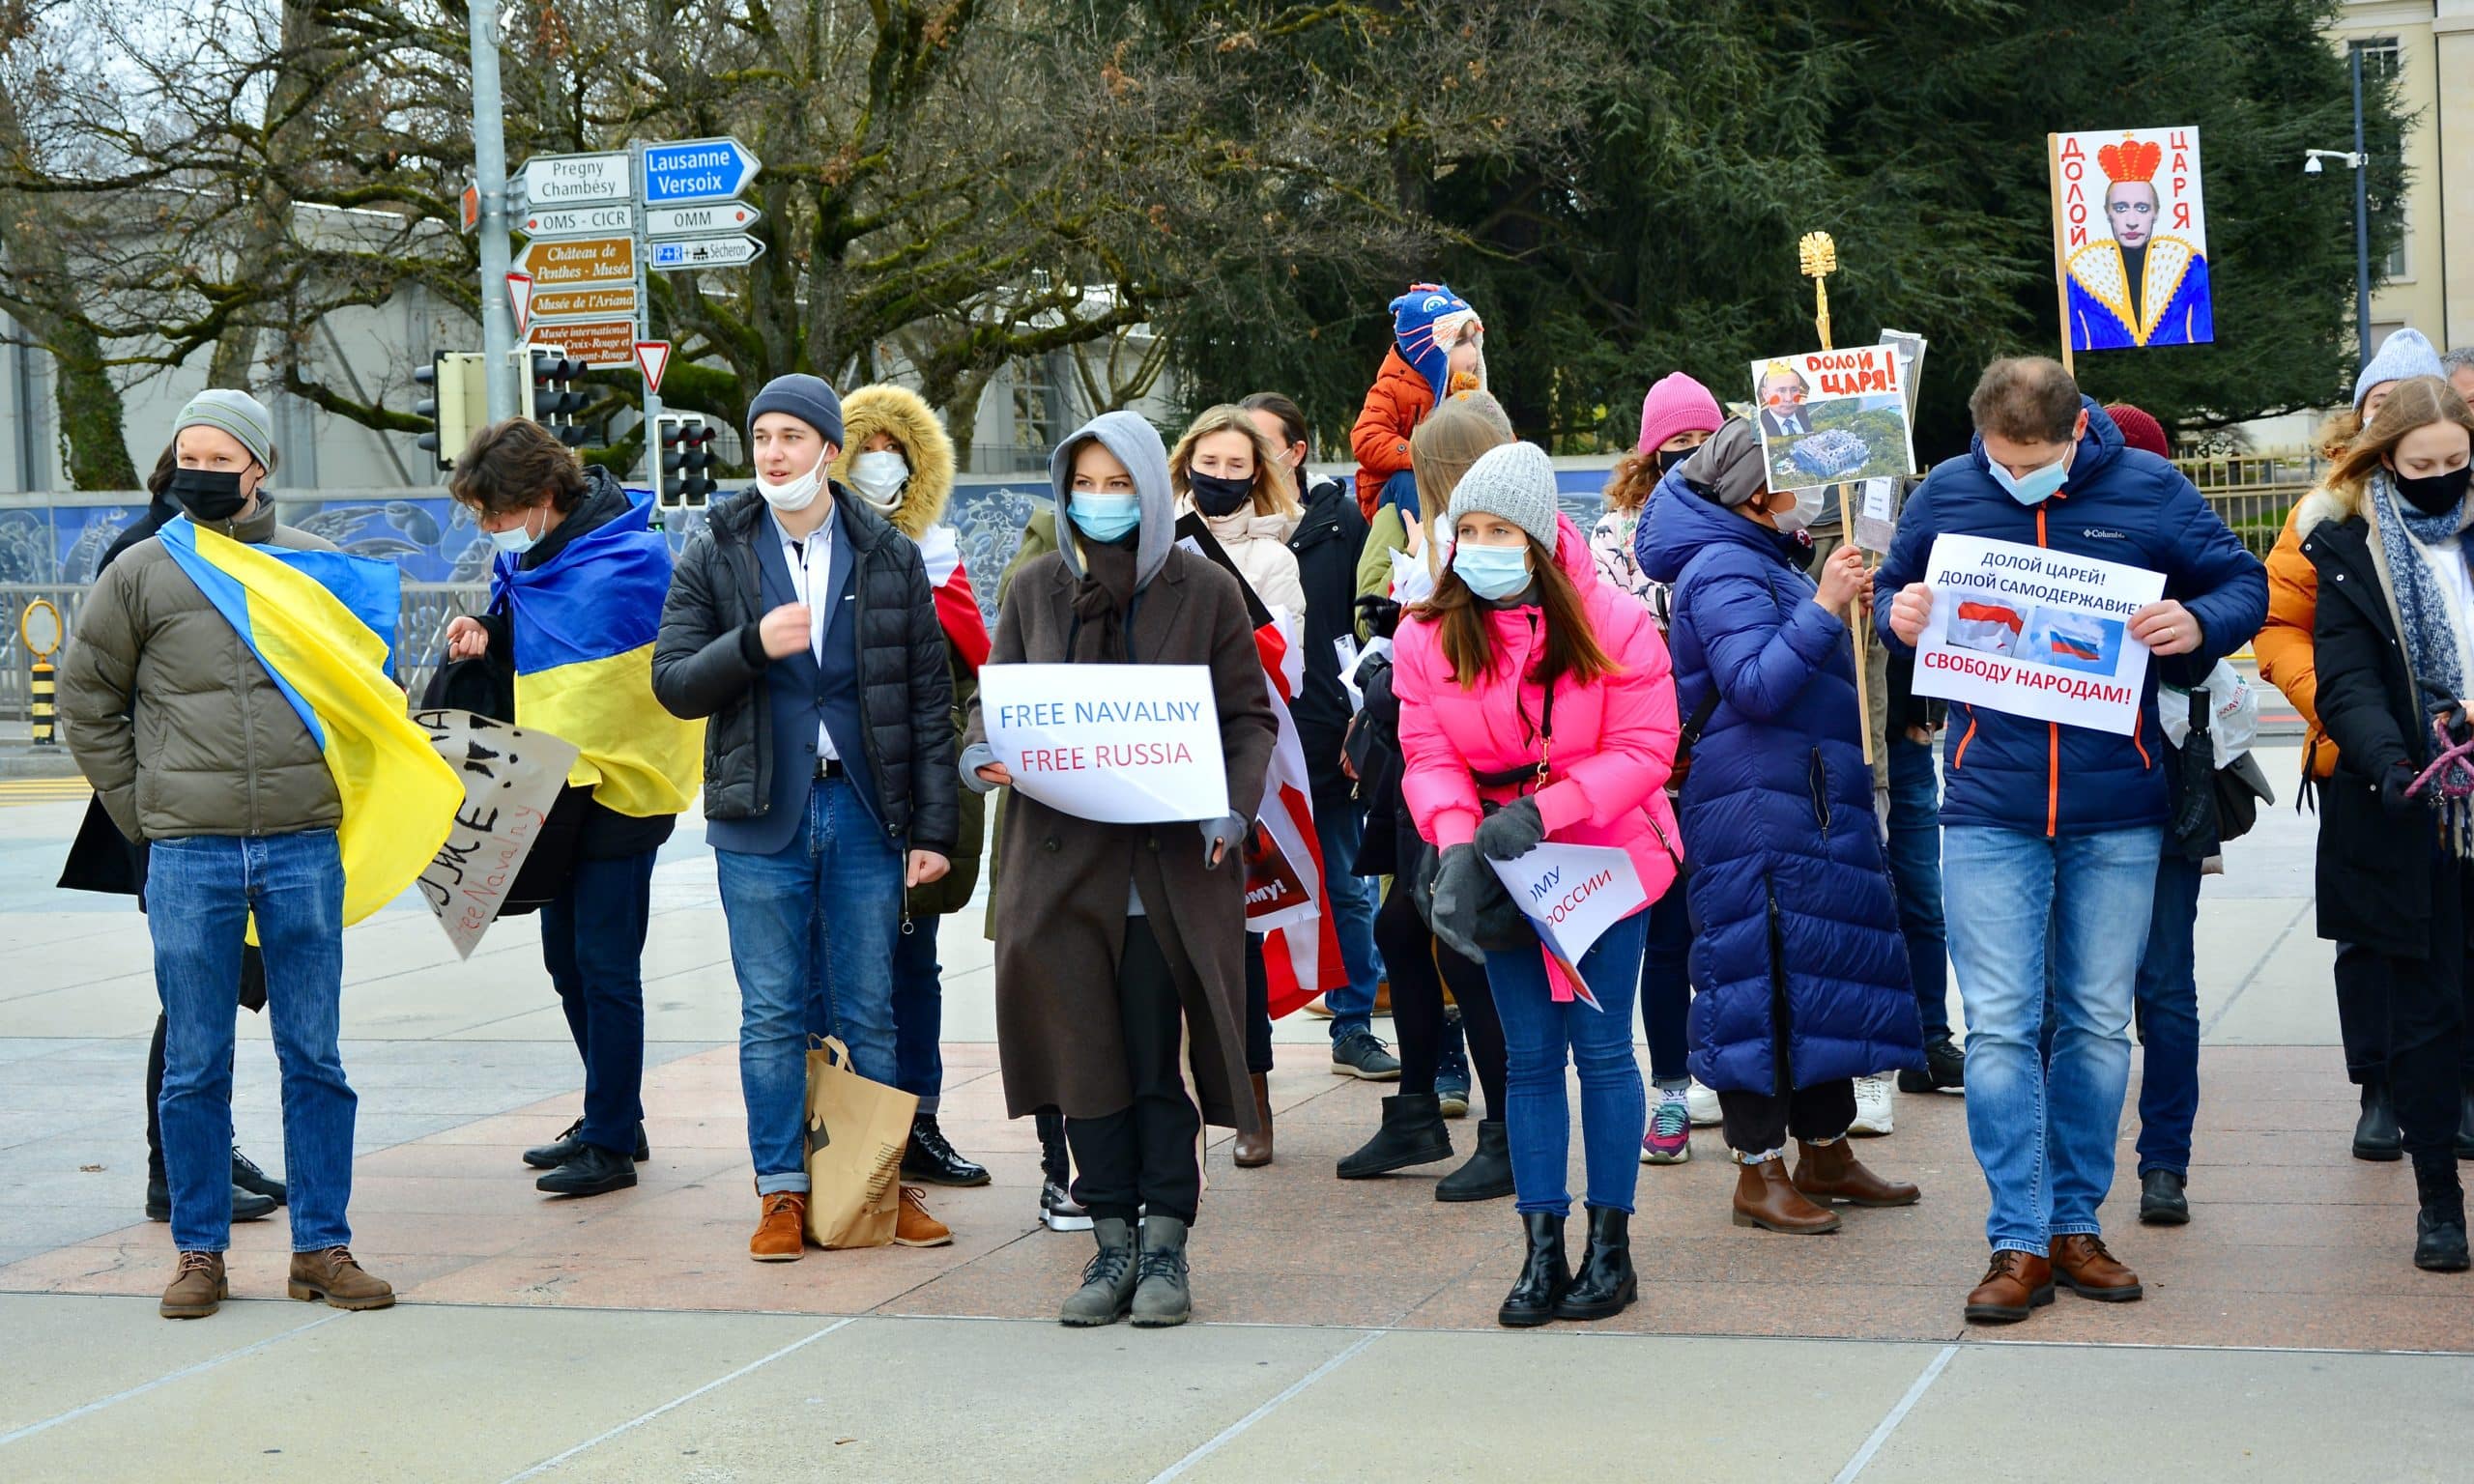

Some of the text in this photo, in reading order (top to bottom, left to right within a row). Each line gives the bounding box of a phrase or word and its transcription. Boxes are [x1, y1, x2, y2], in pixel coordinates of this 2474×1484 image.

[553, 162, 604, 179] Pregny
[648, 151, 731, 172] Lausanne
[542, 180, 616, 197] Chambésy
[658, 171, 723, 194] Versoix
[2171, 131, 2191, 229] ЦАРЯ
[2060, 137, 2087, 245] ДОЛОЙ
[543, 214, 576, 231] OMS
[591, 211, 625, 227] CICR
[674, 211, 711, 227] OMM
[547, 243, 617, 262] Château de
[537, 265, 581, 281] Penthes
[592, 261, 630, 277] Musée
[537, 294, 634, 310] Musée de l'Ariana
[539, 324, 629, 338] Musée international
[564, 337, 619, 350] Croix-Rouge
[1821, 351, 1897, 395] ЦАРЯ!
[1981, 552, 2107, 586] ДОЛОЙ ЦАРЕЙ!
[1938, 570, 1997, 589] ДОЛОЙ
[1924, 651, 2132, 704] СВОБОДУ НАРОДАМ!
[1001, 700, 1200, 728] FREE NAVALNY
[1021, 742, 1193, 772] FREE RUSSIA
